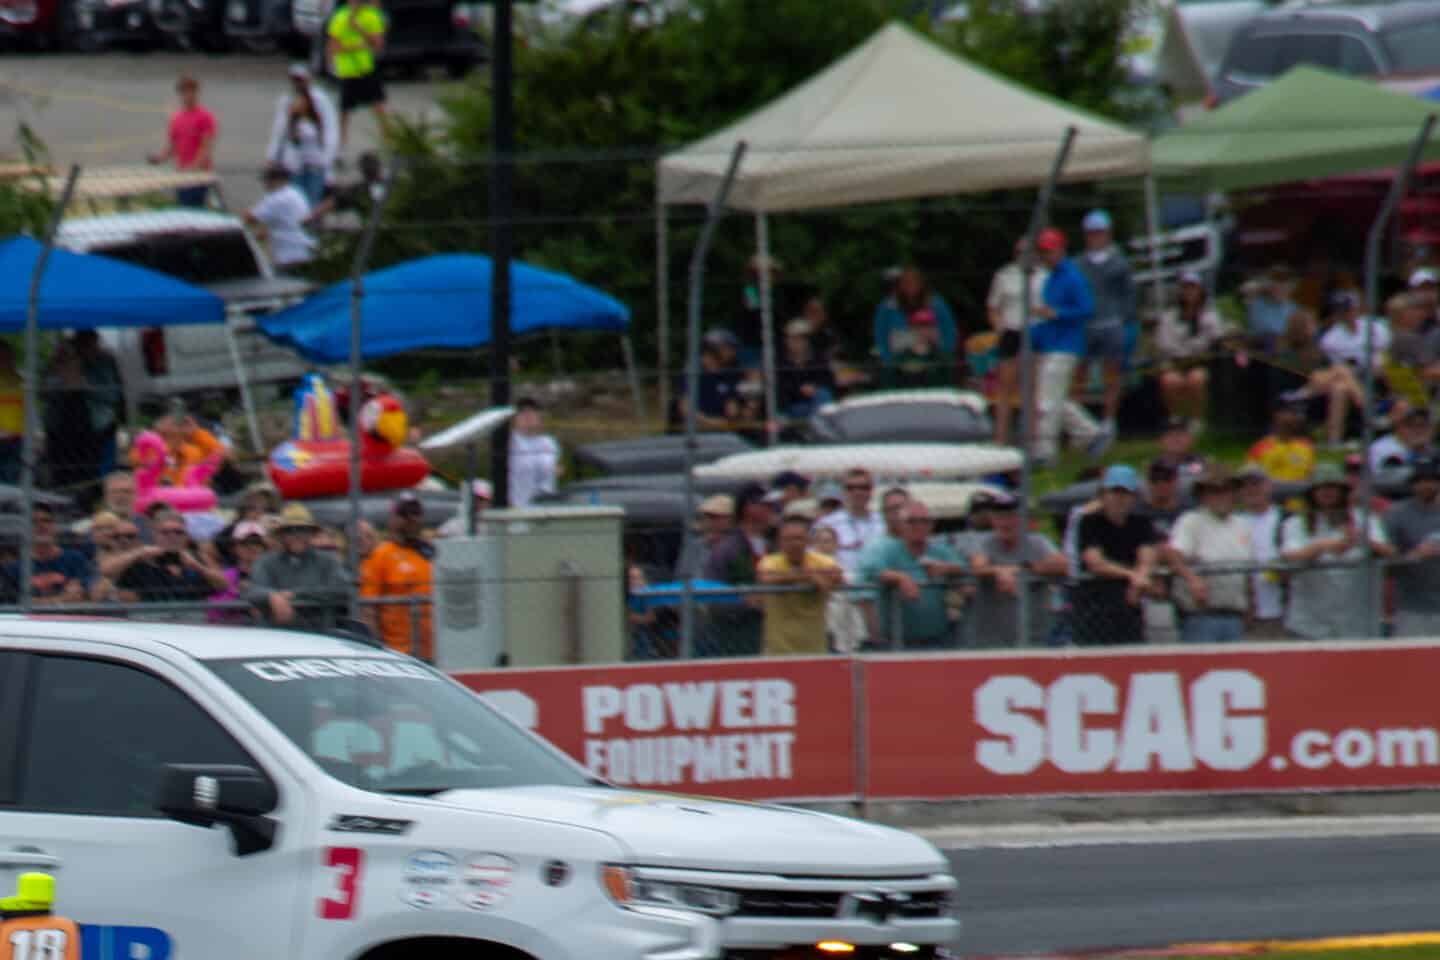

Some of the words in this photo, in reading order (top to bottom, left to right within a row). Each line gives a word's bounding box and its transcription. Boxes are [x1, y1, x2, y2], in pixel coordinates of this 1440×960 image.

[581, 679, 796, 732] POWER
[585, 733, 796, 784] EQUIPMENT
[318, 847, 365, 920] 3
